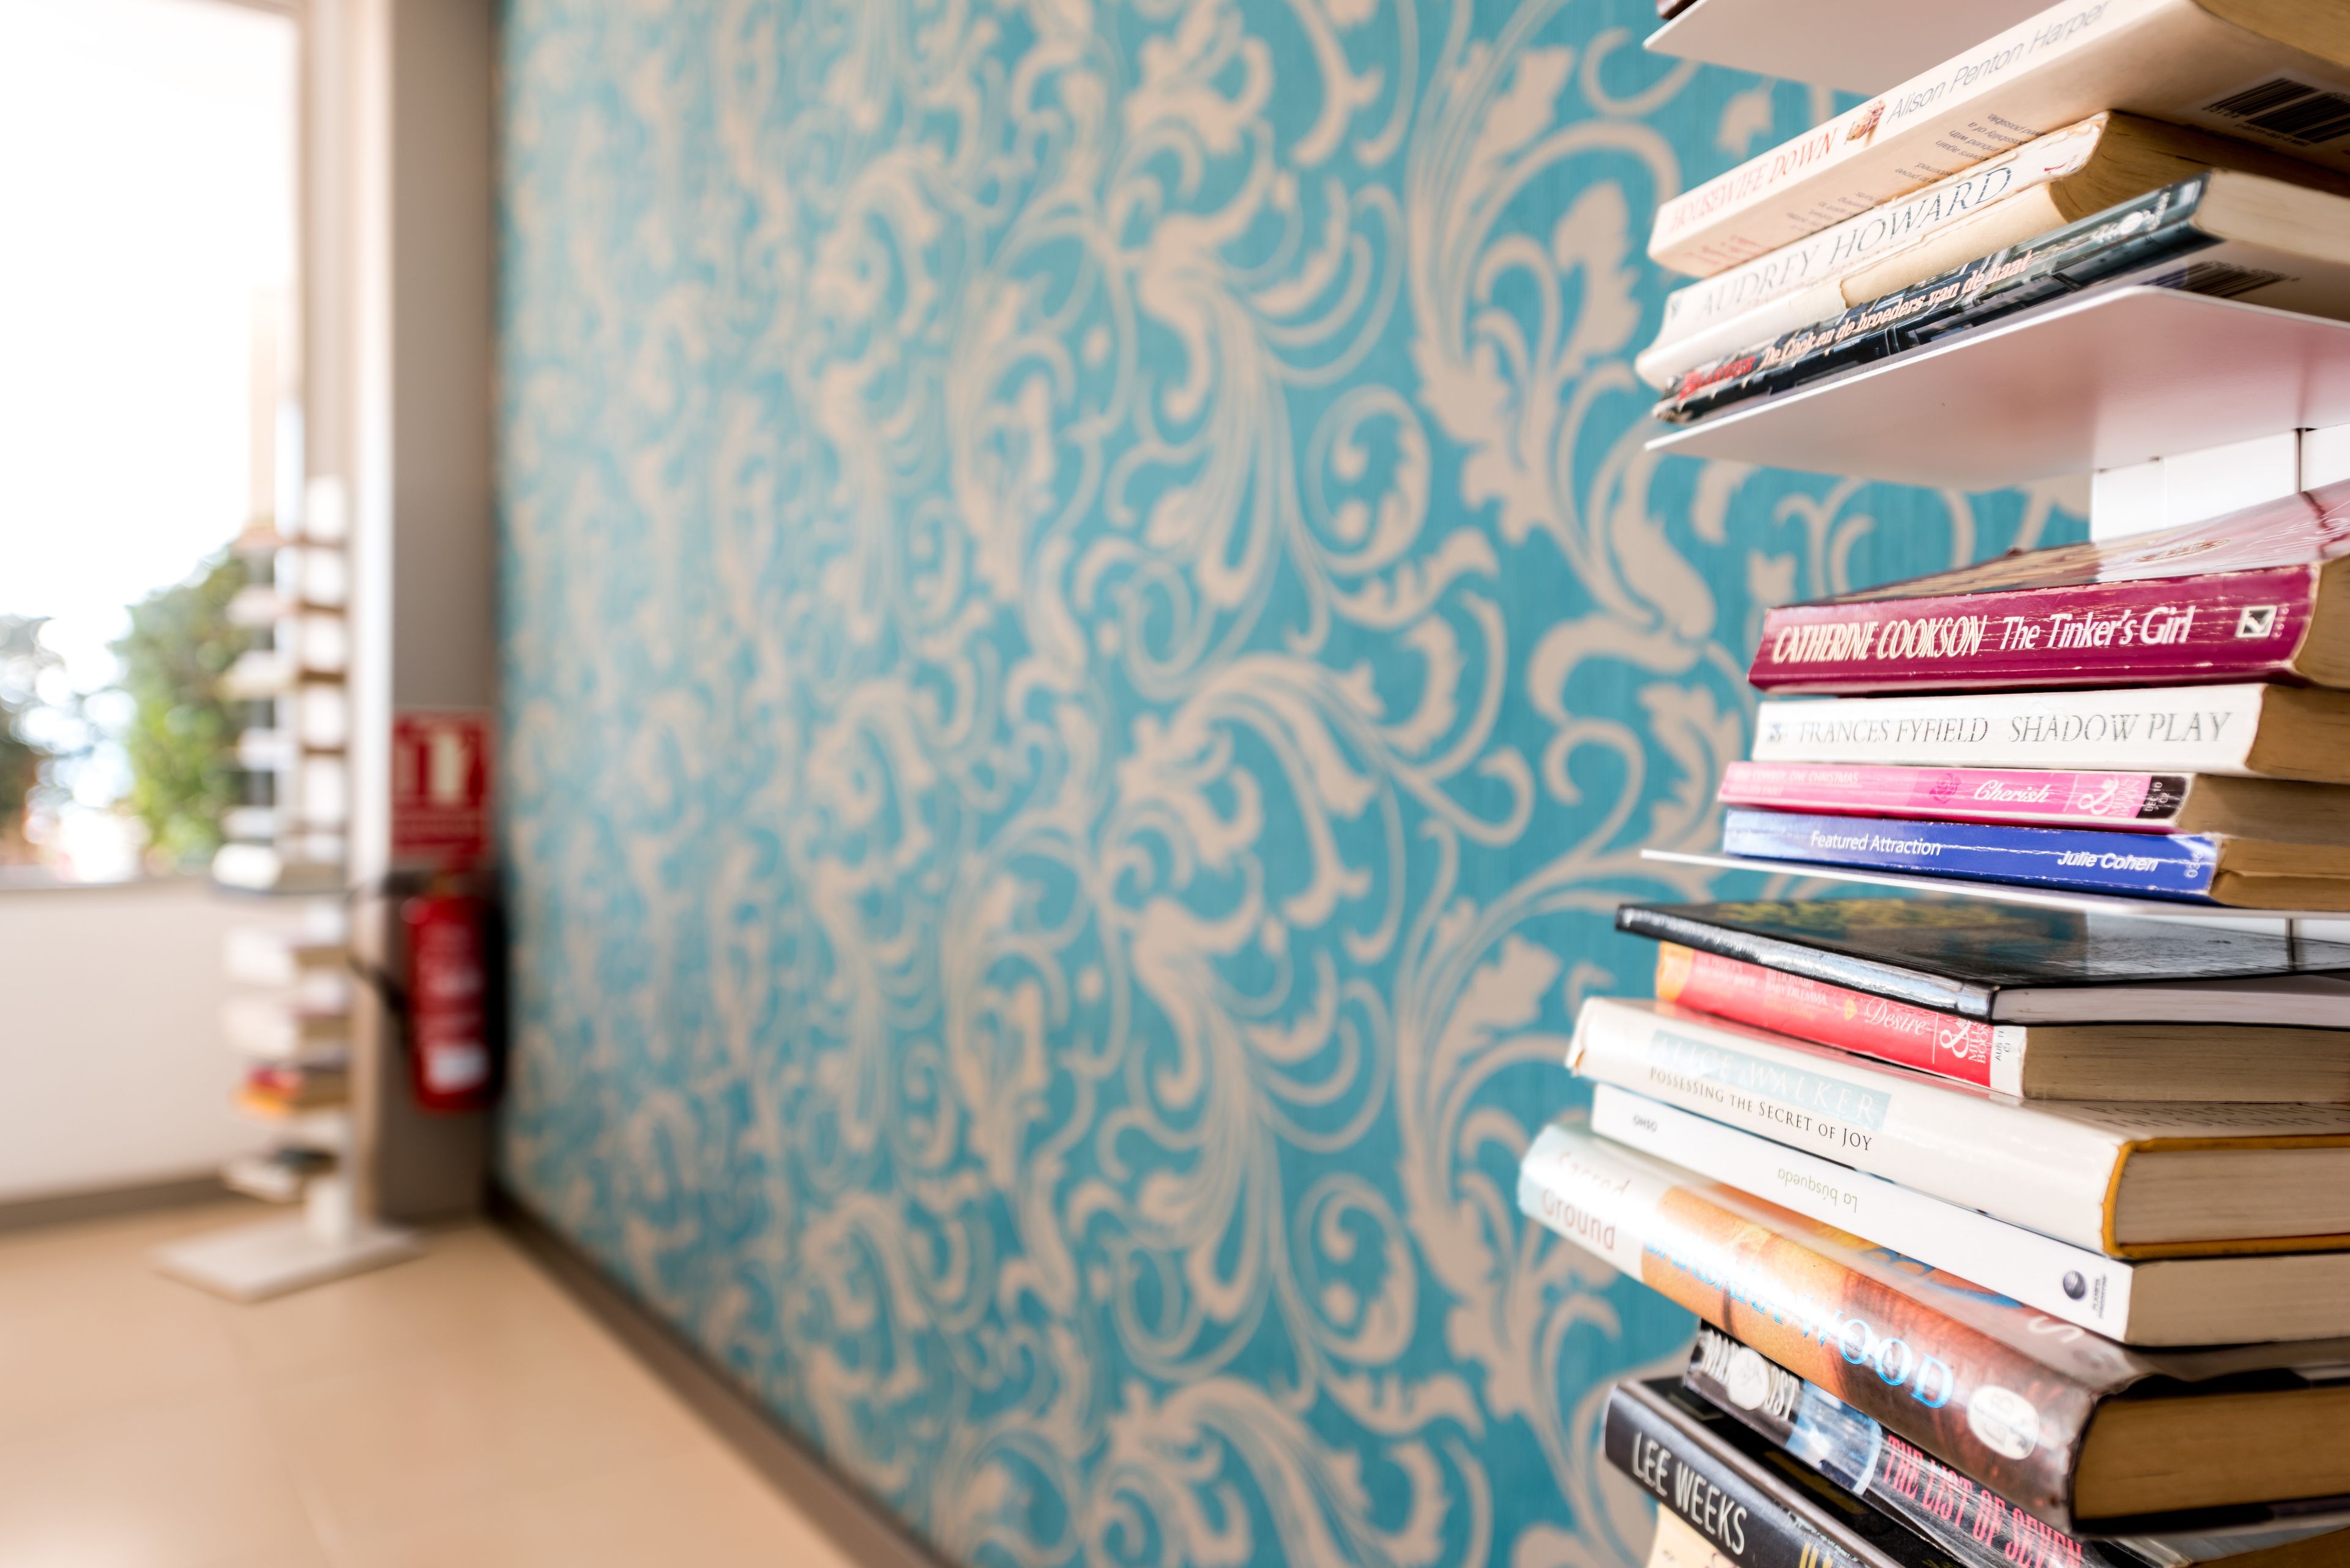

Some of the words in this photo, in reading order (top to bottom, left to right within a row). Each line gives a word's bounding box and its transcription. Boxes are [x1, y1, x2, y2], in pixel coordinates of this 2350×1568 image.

[1887, 83, 1945, 124] Alison
[1950, 40, 2024, 94] Penton
[2029, 1, 2109, 57] Harper
[1934, 140, 1960, 153] again
[1949, 130, 1967, 143] with
[1769, 128, 1838, 184] DOWN
[1895, 168, 1920, 180] prove
[1829, 167, 2012, 266] HOWARD
[1761, 346, 1781, 367] De
[1781, 332, 1816, 360] Cock
[1816, 329, 1836, 348] en
[1836, 317, 1856, 341] de
[1856, 294, 1923, 332] broeders
[1928, 283, 1960, 306] van
[1961, 270, 1983, 295] de
[1982, 250, 2033, 286] haat
[1772, 621, 1879, 664] CATHERINE
[1876, 614, 1988, 660] COOKSON
[1999, 616, 2041, 650] The
[2045, 610, 2137, 648] Tinker's
[2140, 605, 2196, 645] Girl
[1799, 718, 1890, 743] FRANCES
[1896, 717, 1988, 743] FYFIELD
[2008, 712, 2146, 743] SHADOW
[2148, 711, 2234, 742] PLAY
[1808, 771, 1860, 785] CHRISTMAS
[1974, 779, 2051, 803] Cherish
[2143, 796, 2159, 812] DEC
[2153, 781, 2163, 793] 10
[1811, 830, 1868, 851] Featured
[1870, 835, 1941, 856] Attraction
[2057, 850, 2097, 868] Julie
[2100, 853, 2160, 872] Cohen
[1864, 998, 1928, 1036] Desire
[1649, 1066, 1725, 1103] POSSESSING
[1729, 1094, 1753, 1114] THE
[1758, 1101, 1813, 1132] SECRET
[1818, 1122, 1836, 1140] OF
[1841, 1128, 1873, 1152] JOY
[1747, 1062, 1875, 1124] WALKER
[1778, 1168, 1838, 1207] búsqueda
[1844, 1192, 1858, 1213] La
[1540, 1187, 1617, 1251] Ground
[1632, 1431, 1672, 1498] LEE
[1674, 1460, 1748, 1556] WEEKS
[1883, 1435, 1924, 1501] THE
[1921, 1458, 1974, 1528] LIST
[1972, 1489, 2006, 1548] OF
